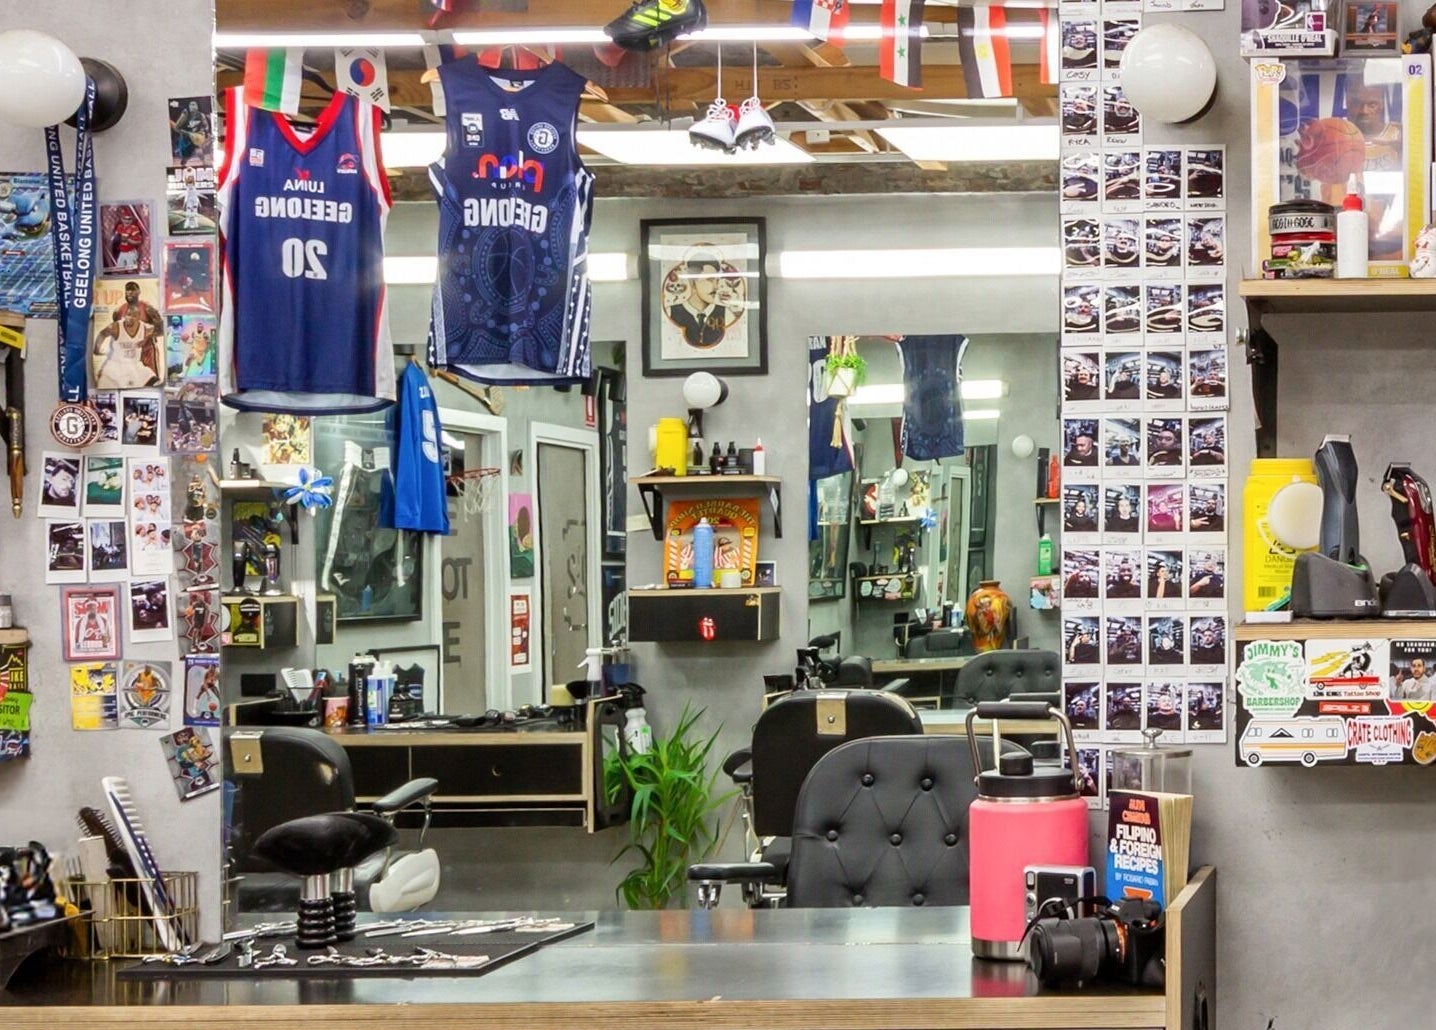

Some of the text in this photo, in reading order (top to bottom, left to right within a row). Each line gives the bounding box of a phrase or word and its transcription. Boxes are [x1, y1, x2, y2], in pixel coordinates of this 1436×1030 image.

[1408, 65, 1422, 76] 02
[51, 154, 66, 207] UNITED
[74, 181, 93, 309] GEELONG UNITED
[56, 210, 74, 309] BASKETBALL
[1247, 643, 1300, 661] JIMMY'S
[1246, 697, 1300, 707] BARBERSHOP
[1348, 720, 1412, 747] CRATE CLOTHING
[1115, 824, 1157, 844] FILIPINO
[1110, 837, 1162, 861] & FOREIGN
[1114, 853, 1158, 875] RECIPES
